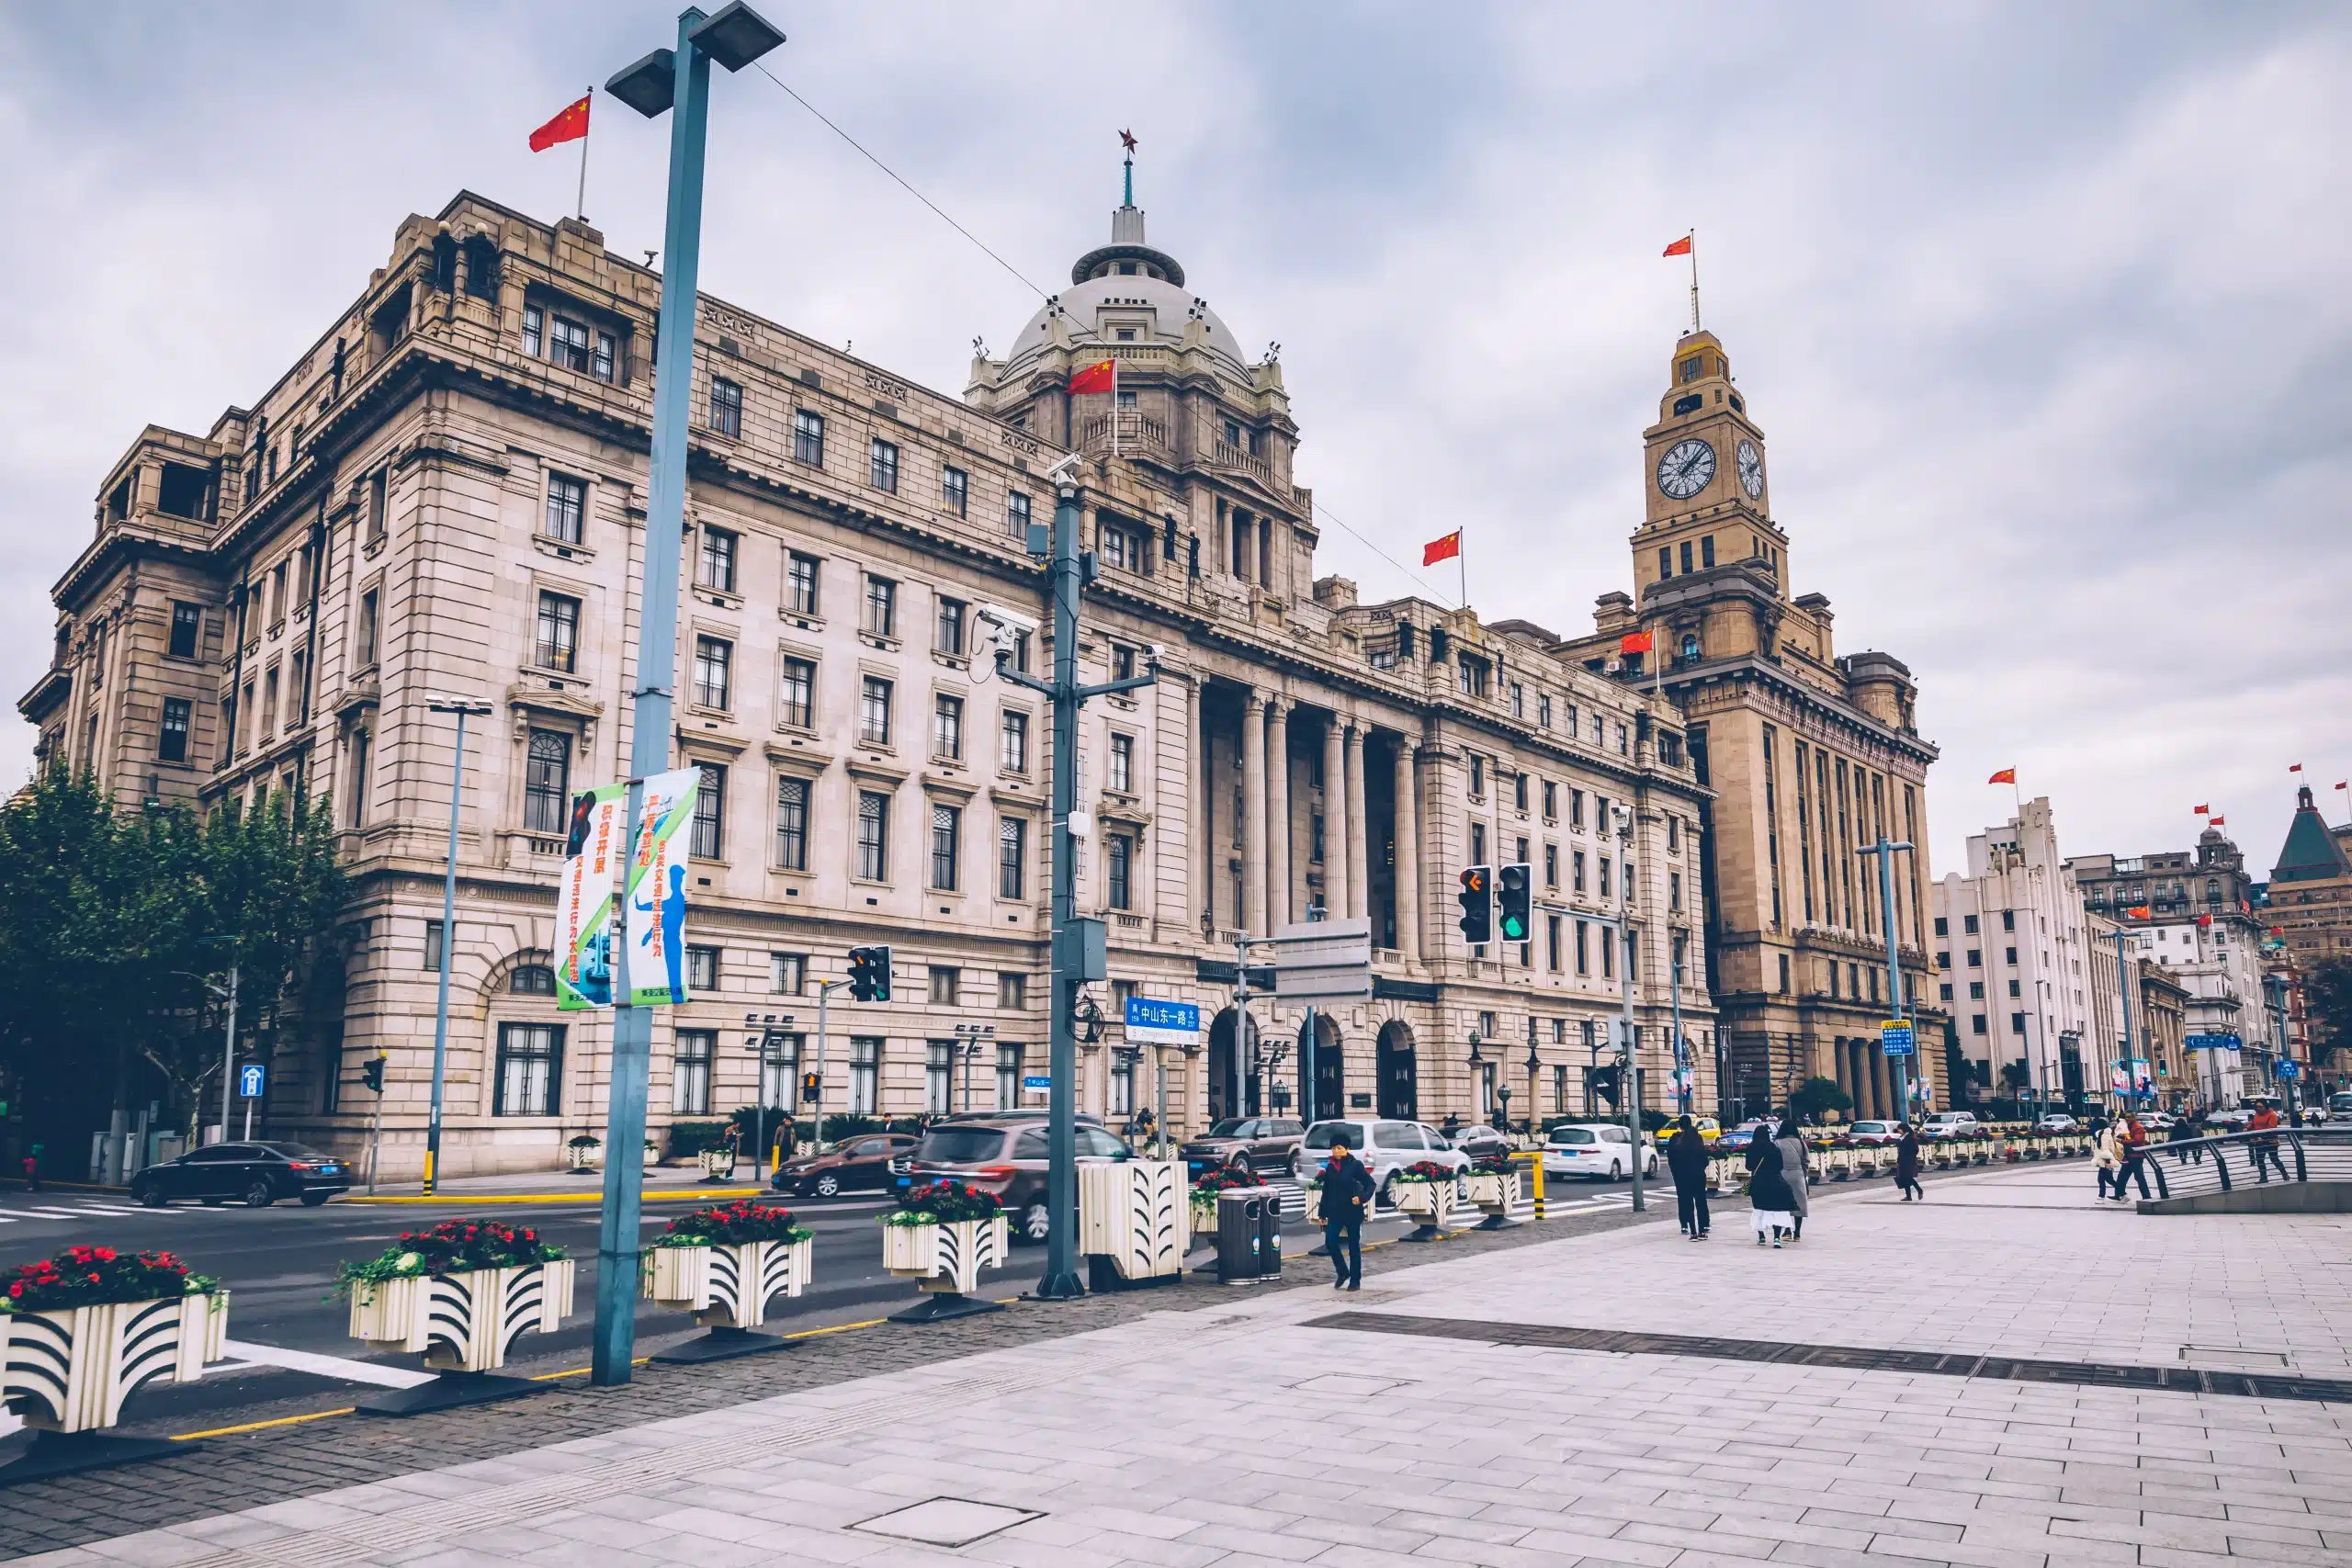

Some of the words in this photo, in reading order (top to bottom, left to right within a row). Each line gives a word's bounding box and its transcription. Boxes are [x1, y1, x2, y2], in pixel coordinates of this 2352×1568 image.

[639, 795, 660, 867] 严厉查处
[651, 840, 666, 958] 各类交通违法行为
[1132, 1003, 1138, 1014] 南
[1141, 1005, 1186, 1026] 中山东一路
[1188, 1010, 1194, 1020] 北
